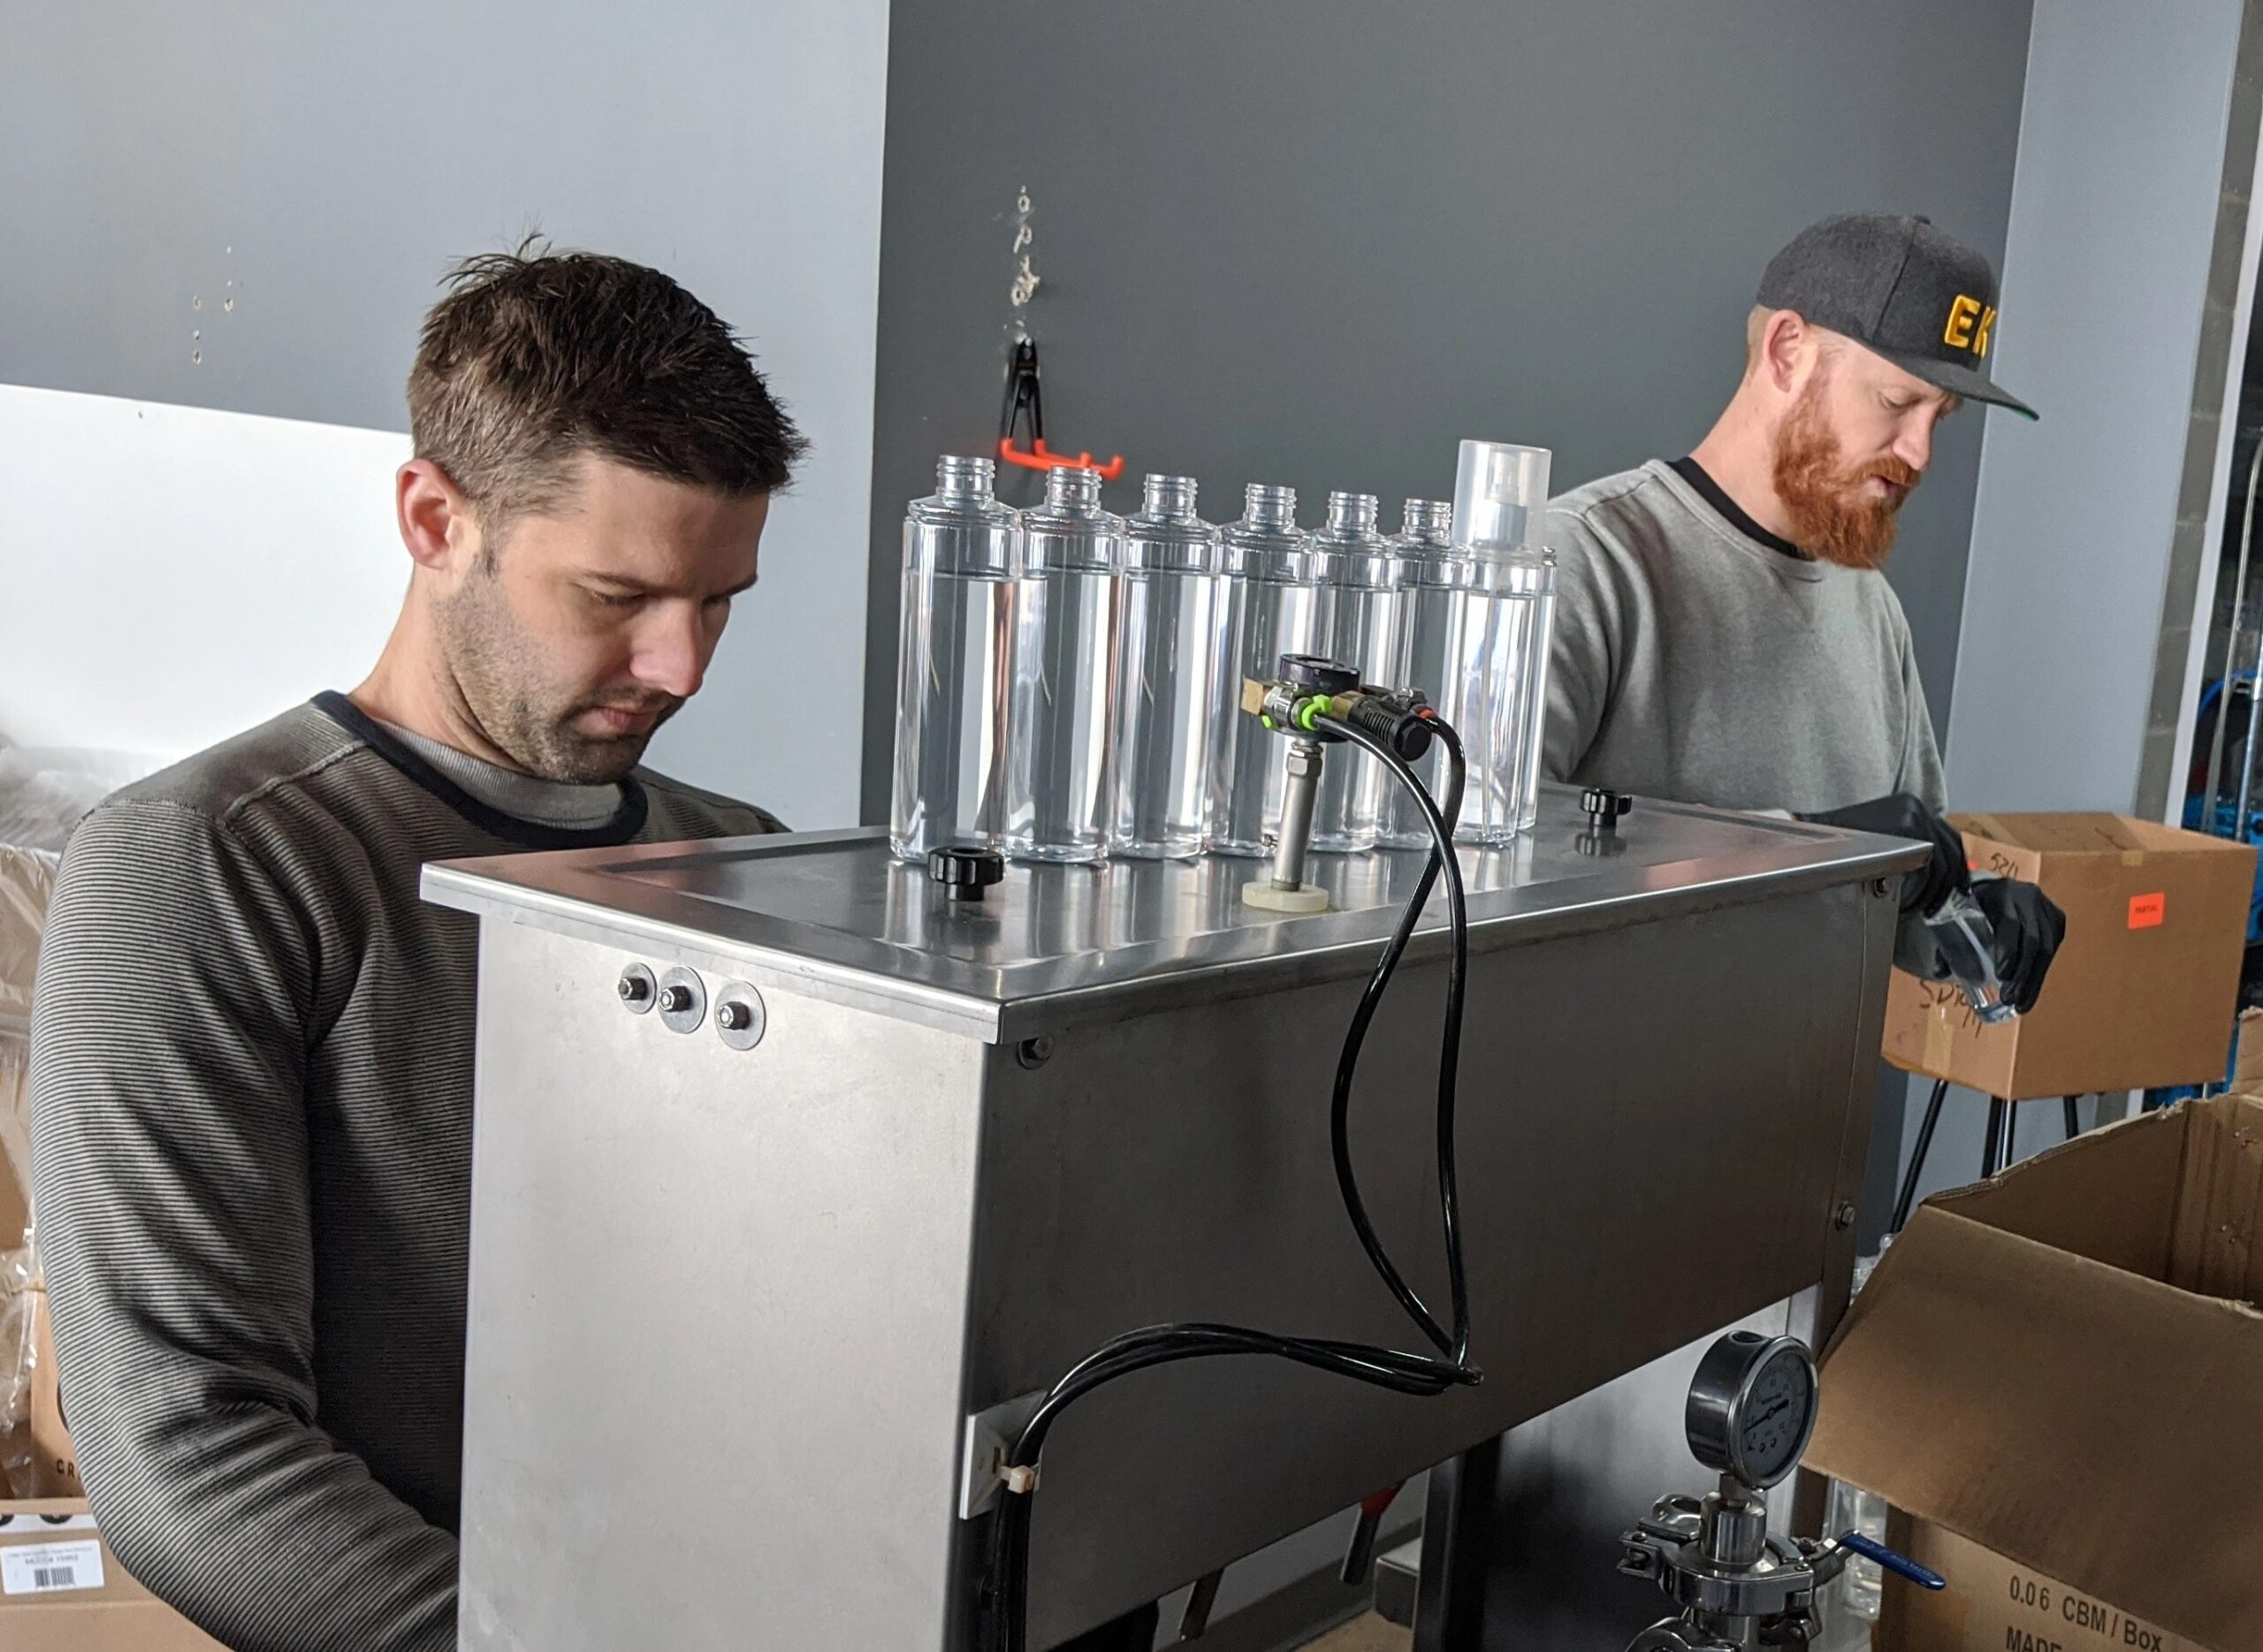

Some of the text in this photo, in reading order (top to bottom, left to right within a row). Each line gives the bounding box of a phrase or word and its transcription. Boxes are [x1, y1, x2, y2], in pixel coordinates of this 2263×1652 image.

[1944, 294, 1997, 359] EK
[2010, 1575, 2162, 1652] 0.06 CBM / Box
